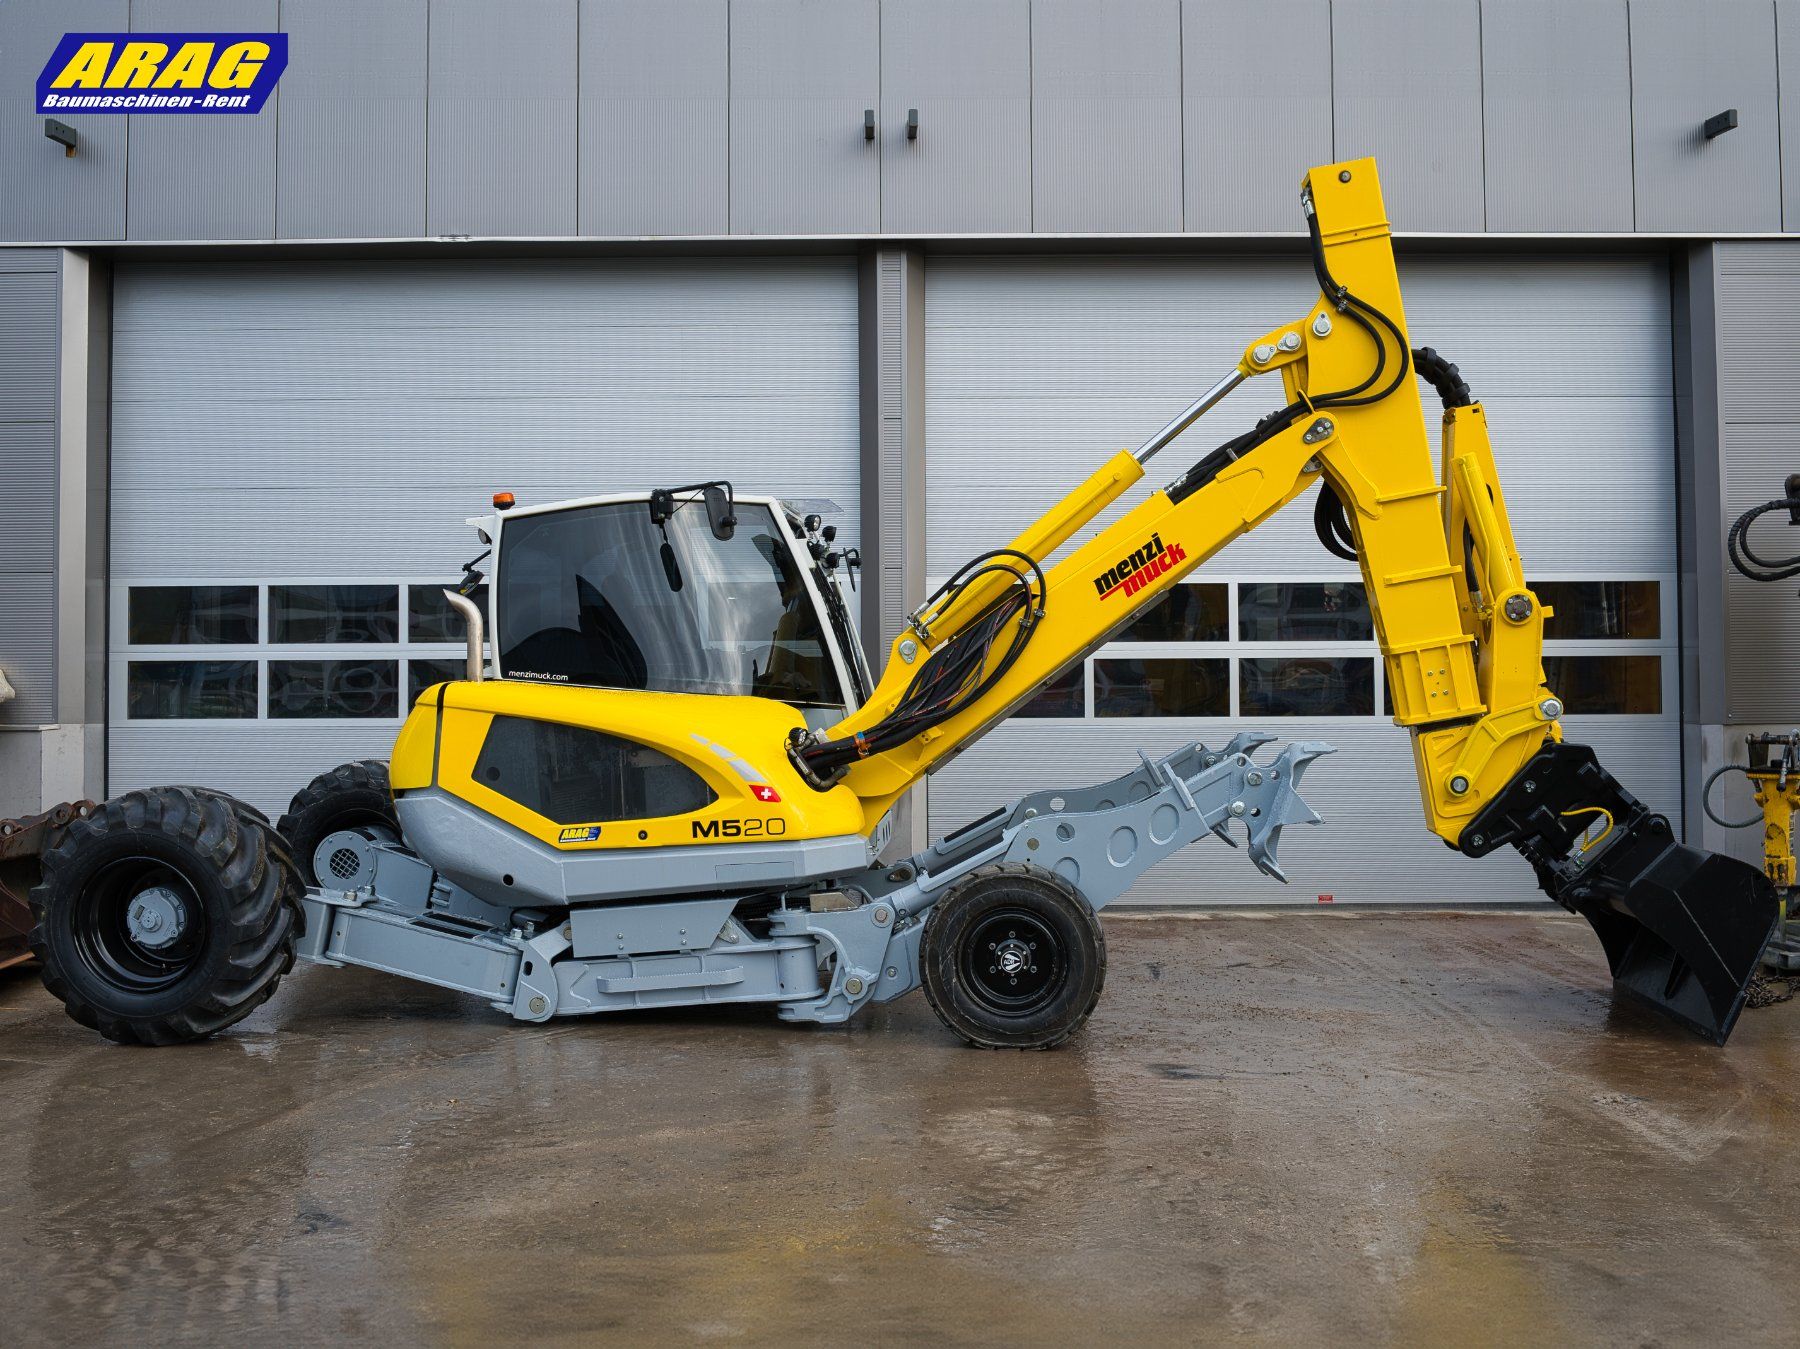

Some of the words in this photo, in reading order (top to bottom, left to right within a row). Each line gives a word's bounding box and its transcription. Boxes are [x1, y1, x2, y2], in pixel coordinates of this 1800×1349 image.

[1093, 531, 1166, 595] menzi
[1100, 542, 1188, 601] muck
[508, 670, 569, 681] menzimuck.com
[561, 827, 590, 839] ARAG
[691, 817, 786, 839] M520
